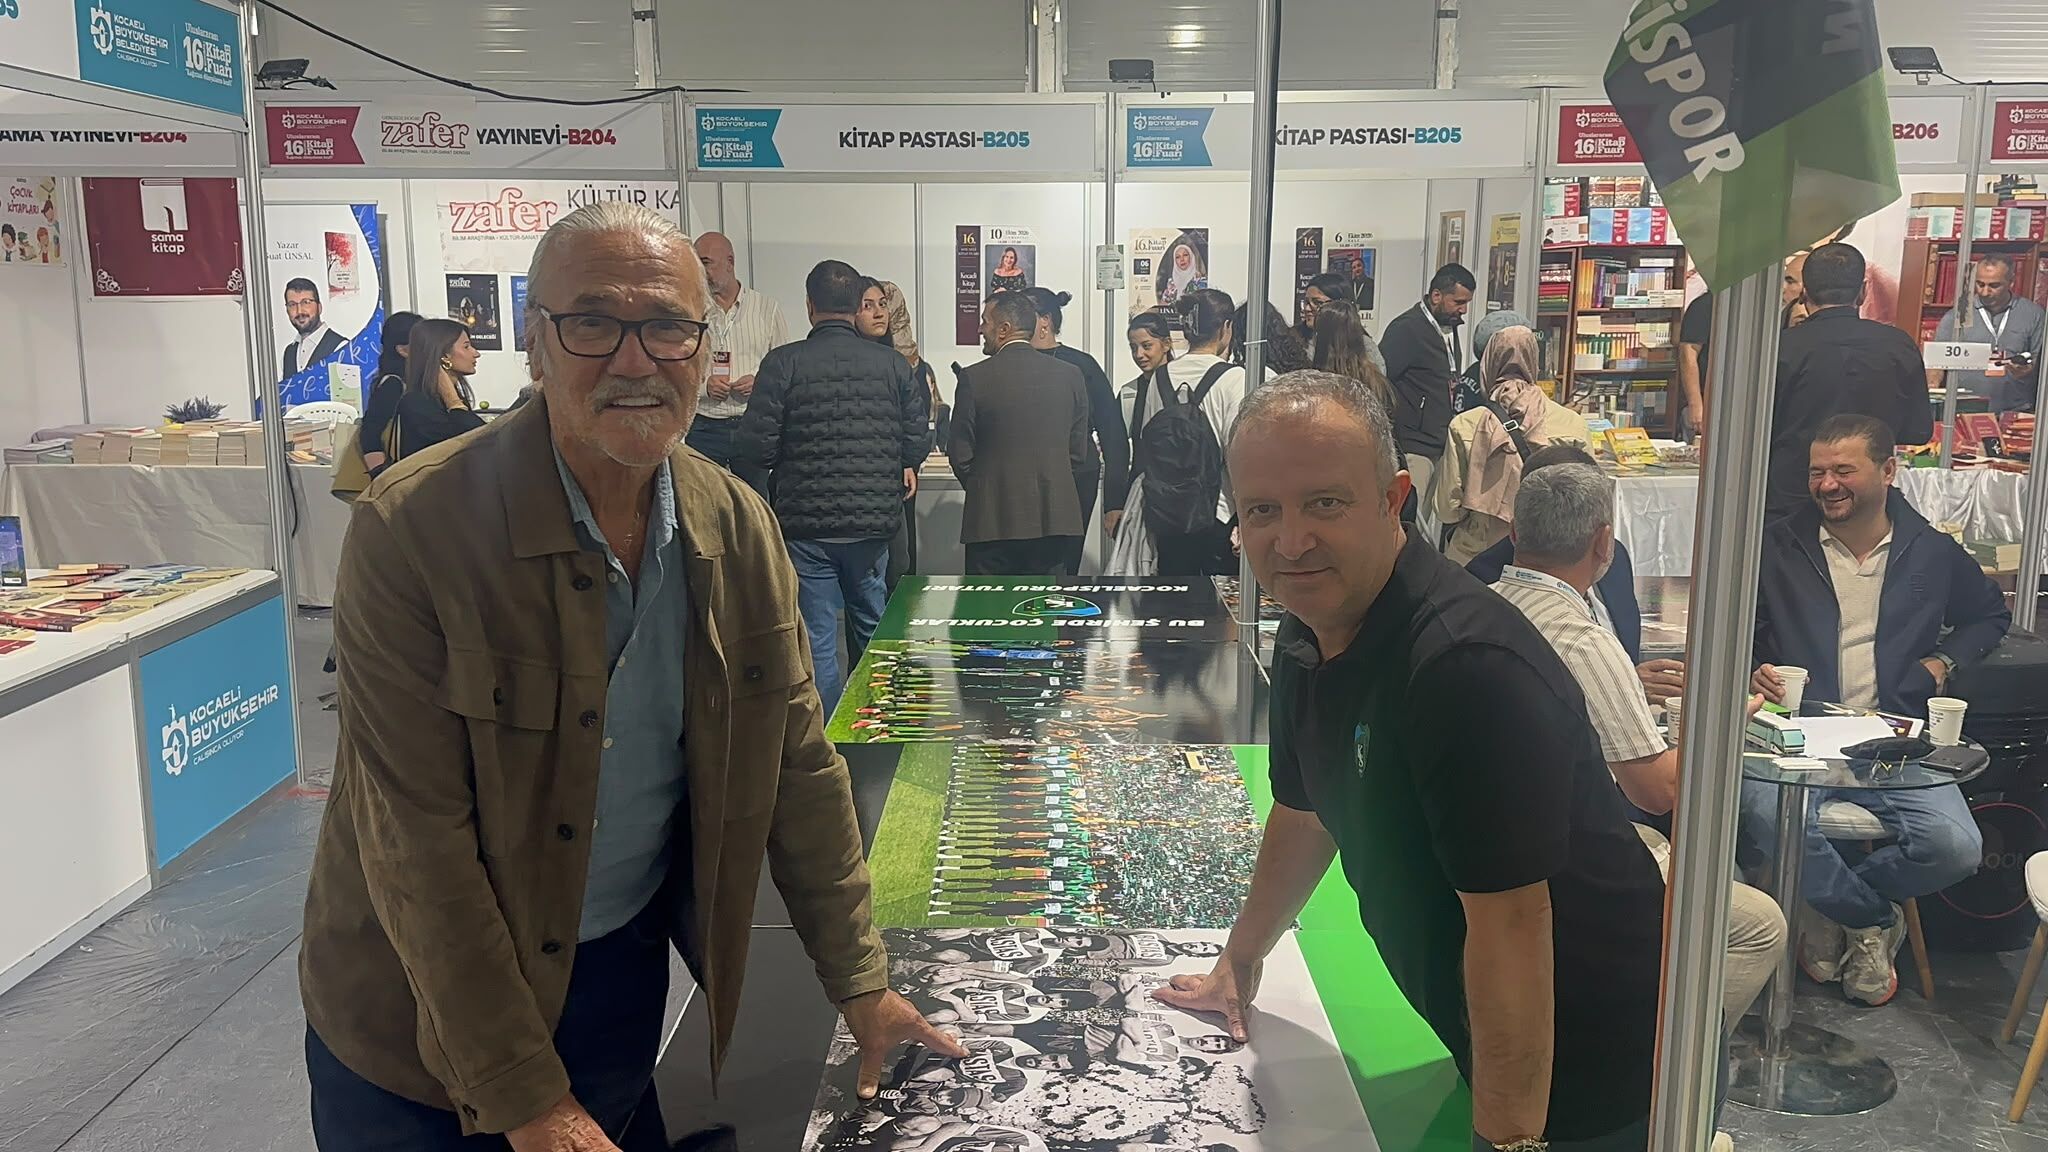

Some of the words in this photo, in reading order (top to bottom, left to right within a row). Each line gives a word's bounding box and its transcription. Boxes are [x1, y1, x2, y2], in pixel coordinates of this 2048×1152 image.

[206, 42, 231, 66] Kitap
[381, 112, 469, 148] zafer
[476, 124, 617, 145] YAYINEVİ-B204
[1892, 123, 1940, 140] B206
[839, 127, 895, 148] KİTAP
[900, 131, 1031, 148] PASTASI-B205
[1329, 127, 1462, 145] PASTASI-B205
[306, 140, 334, 150] Kitap
[725, 142, 753, 152] Kitap
[1156, 141, 1183, 151] Kitap
[1598, 138, 1626, 148] Kitap
[449, 187, 558, 232] zafer
[151, 234, 184, 242] sama
[991, 229, 1002, 239] 10
[1335, 232, 1343, 243] 6
[152, 244, 185, 254] kitap
[276, 241, 299, 249] Yazar
[1945, 346, 1961, 357] 30
[908, 618, 1045, 628] ÇOCUKLAR
[1052, 618, 1159, 628] ŞEHİRDE
[1169, 619, 1206, 627] BU
[189, 686, 241, 726] KOCAELİ
[191, 685, 279, 747] BÜYÜKŞEHİR
